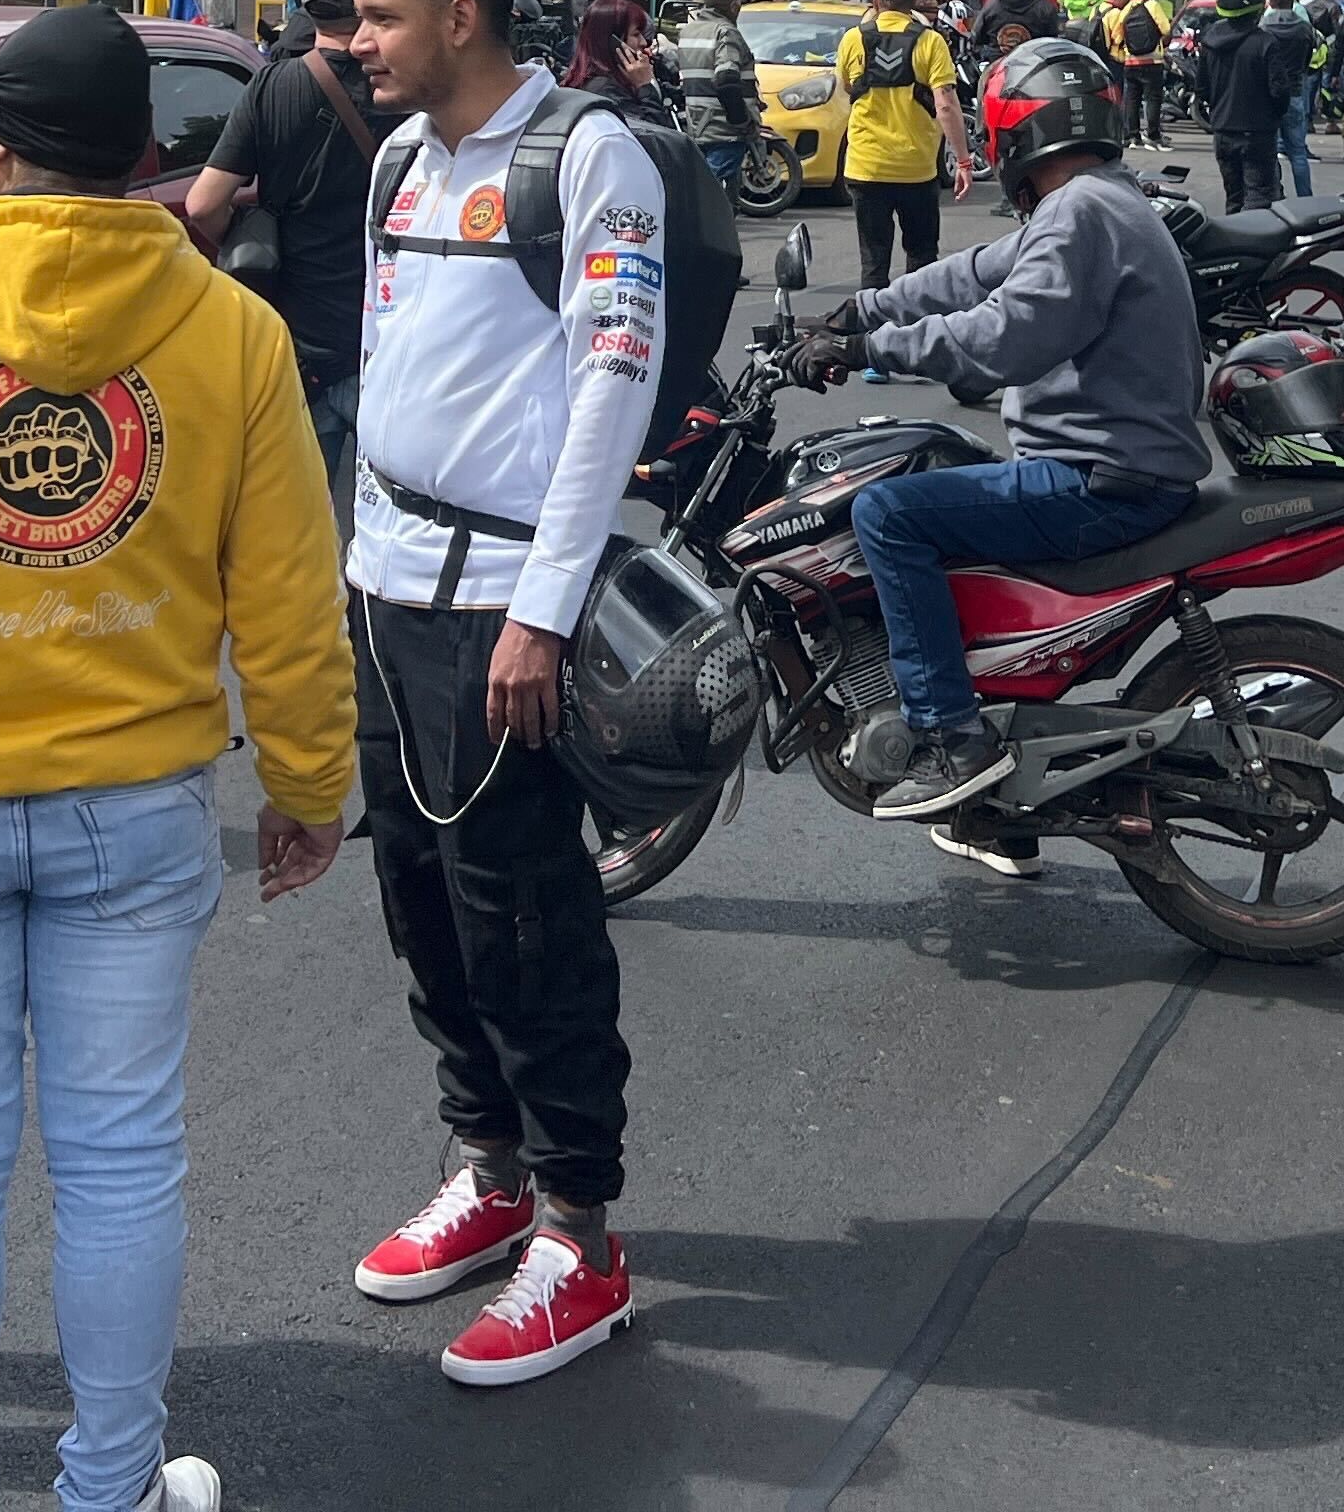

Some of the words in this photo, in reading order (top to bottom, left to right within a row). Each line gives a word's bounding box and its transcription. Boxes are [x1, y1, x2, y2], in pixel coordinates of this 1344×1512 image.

[592, 332, 651, 363] OSRAM
[138, 388, 161, 433] APOYO
[28, 474, 134, 543] BROTHERS
[756, 511, 825, 544] YAMAHA
[21, 554, 65, 567] SOBRE
[67, 531, 119, 565] RUEDAS
